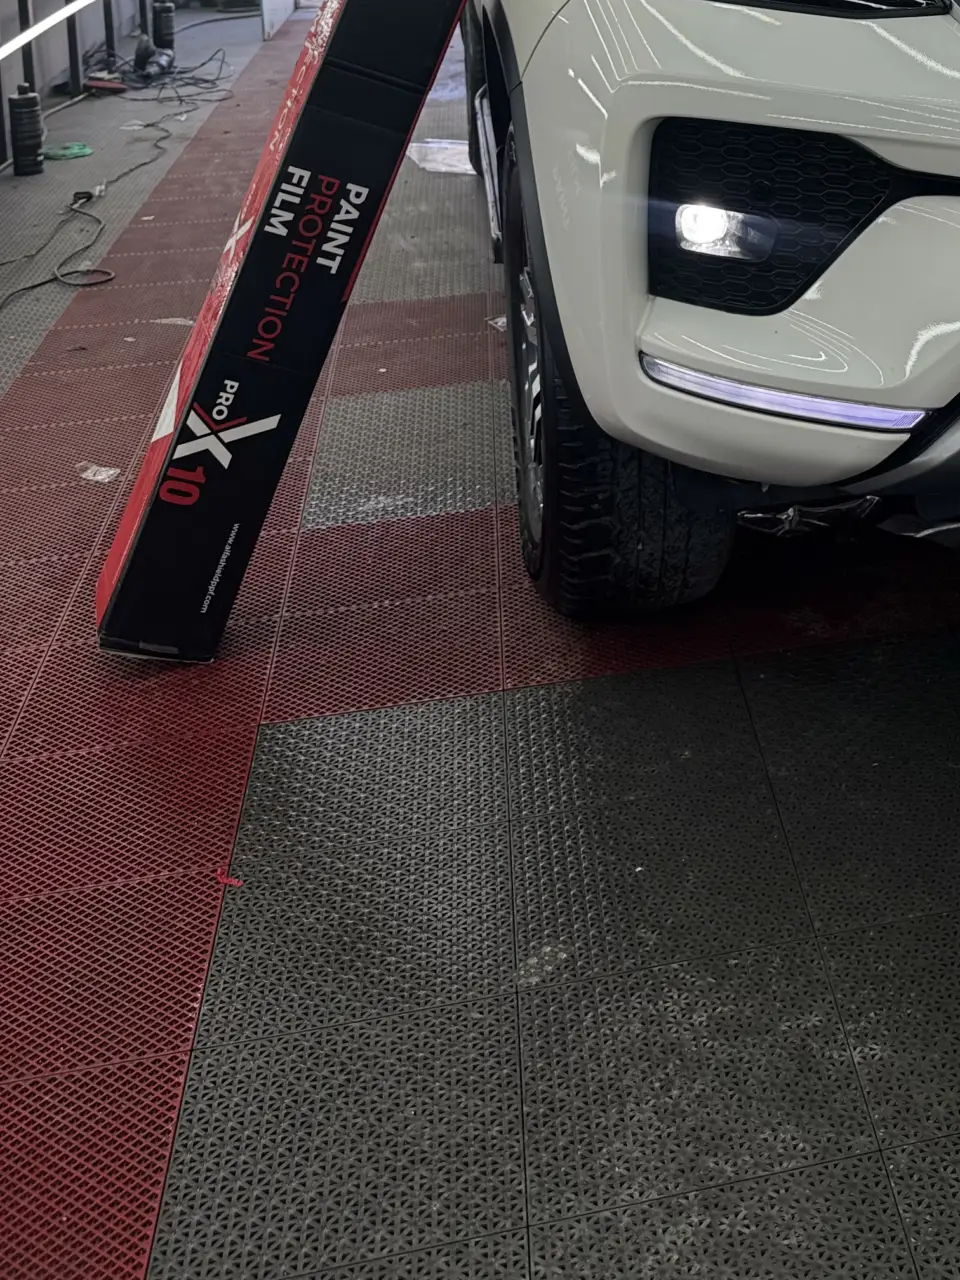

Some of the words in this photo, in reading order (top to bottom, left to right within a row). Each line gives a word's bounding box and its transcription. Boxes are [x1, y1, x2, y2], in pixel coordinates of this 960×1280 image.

[263, 165, 312, 237] FILM
[316, 182, 370, 274] PAINT
[246, 175, 341, 361] PROTECTION
[212, 379, 239, 421] PRO
[200, 523, 240, 614] www.alfashieldppf.com
